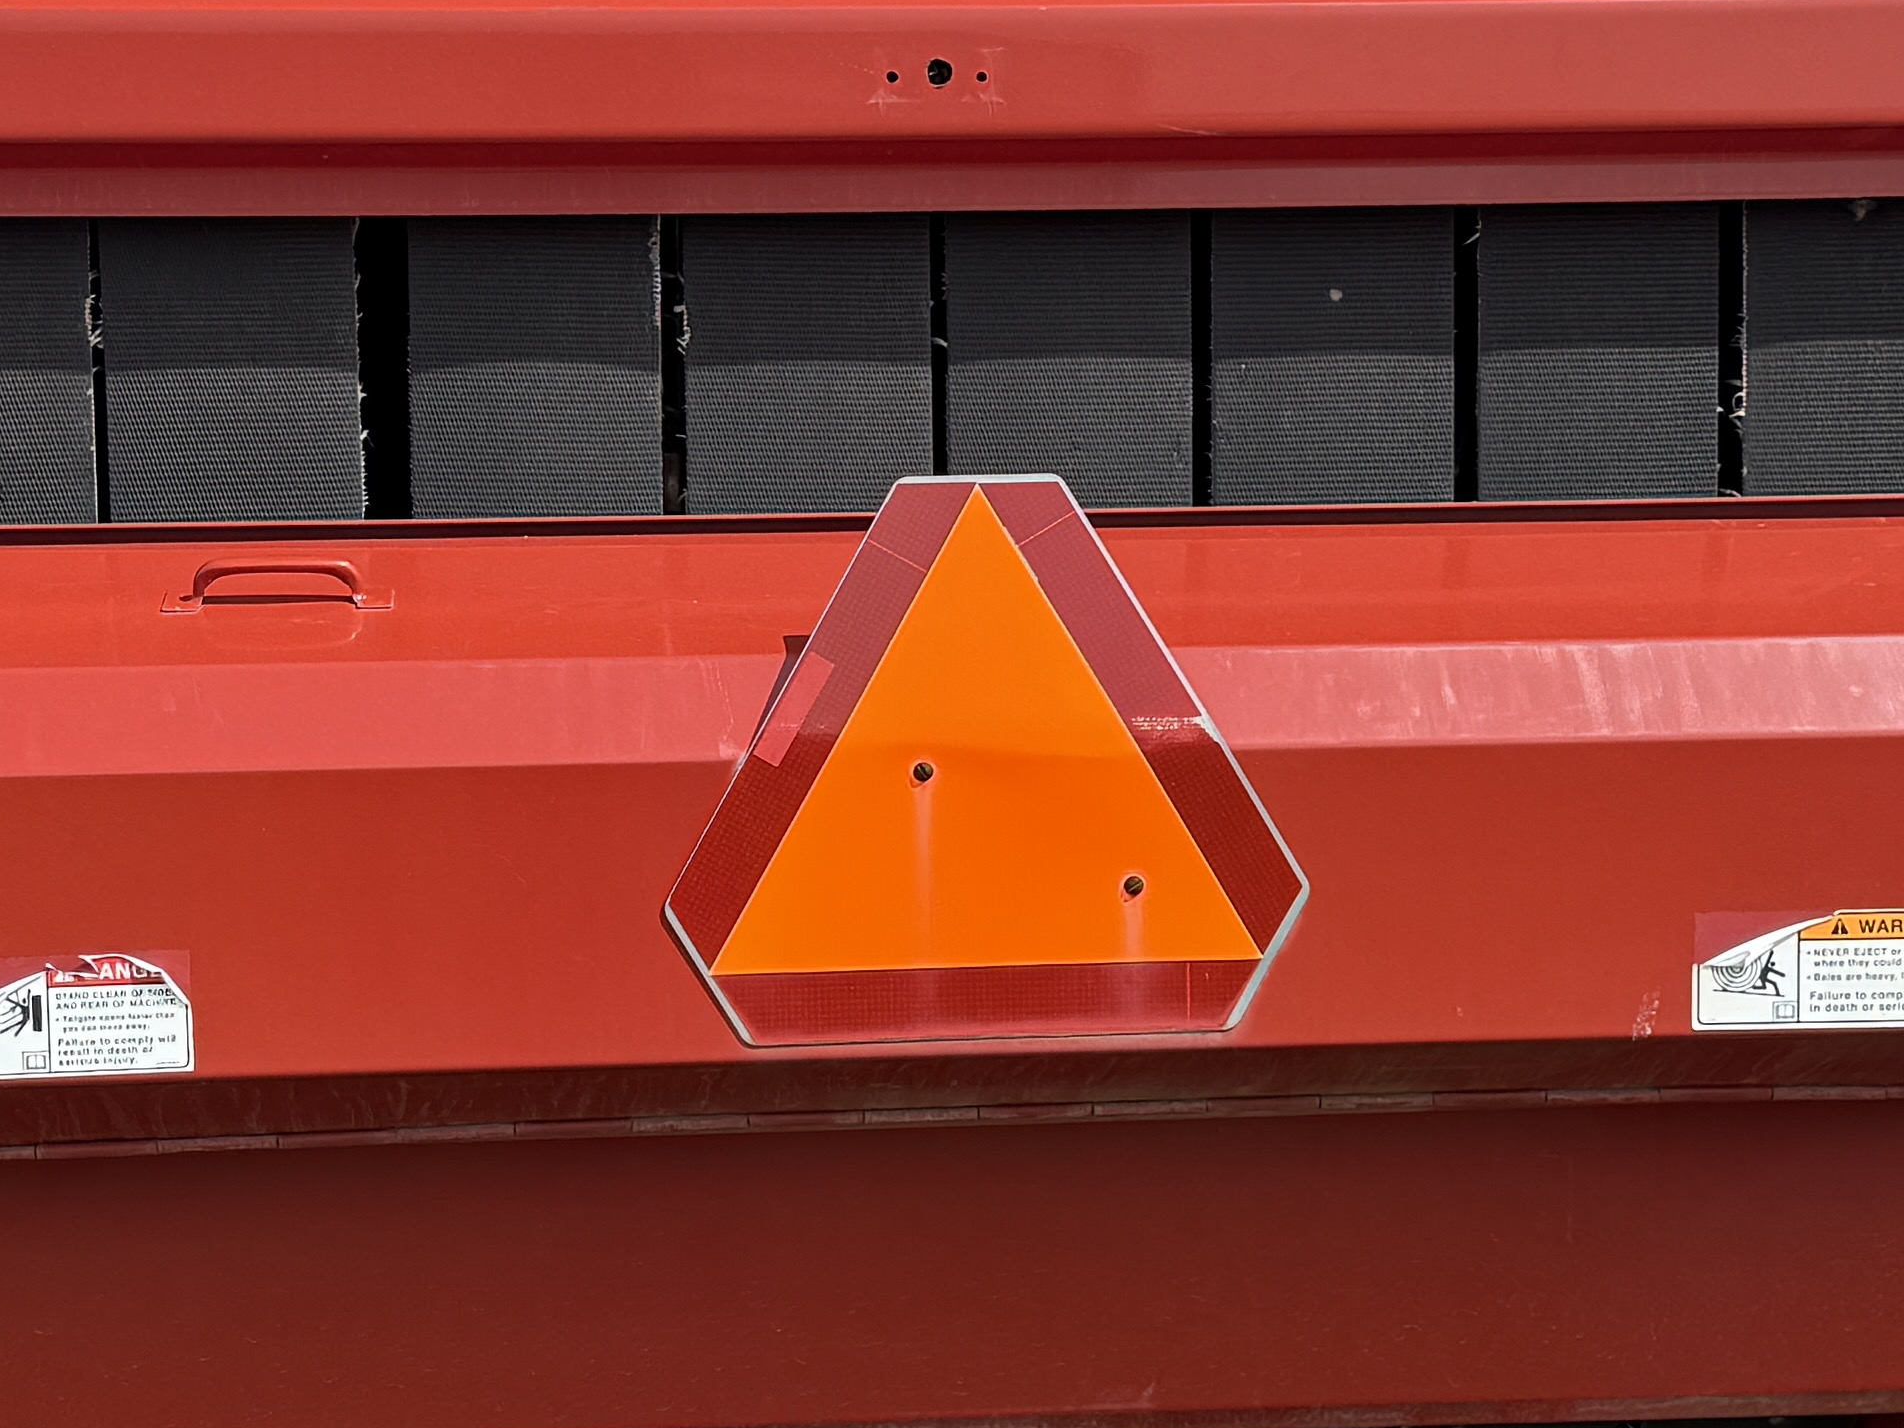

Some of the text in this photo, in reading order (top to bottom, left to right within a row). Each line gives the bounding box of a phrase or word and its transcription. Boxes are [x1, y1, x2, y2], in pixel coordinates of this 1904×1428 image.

[1814, 948, 1849, 956] NEVER
[1854, 948, 1887, 956] EJECT
[1814, 958, 1844, 966] where
[1848, 958, 1869, 968] they
[1873, 958, 1901, 966] could
[1814, 973, 1842, 981] Bales
[1809, 990, 1850, 1000] Failure
[1855, 991, 1867, 1000] to
[1809, 1002, 1821, 1012] in
[1825, 1002, 1857, 1012] death
[1862, 1003, 1873, 1012] or
